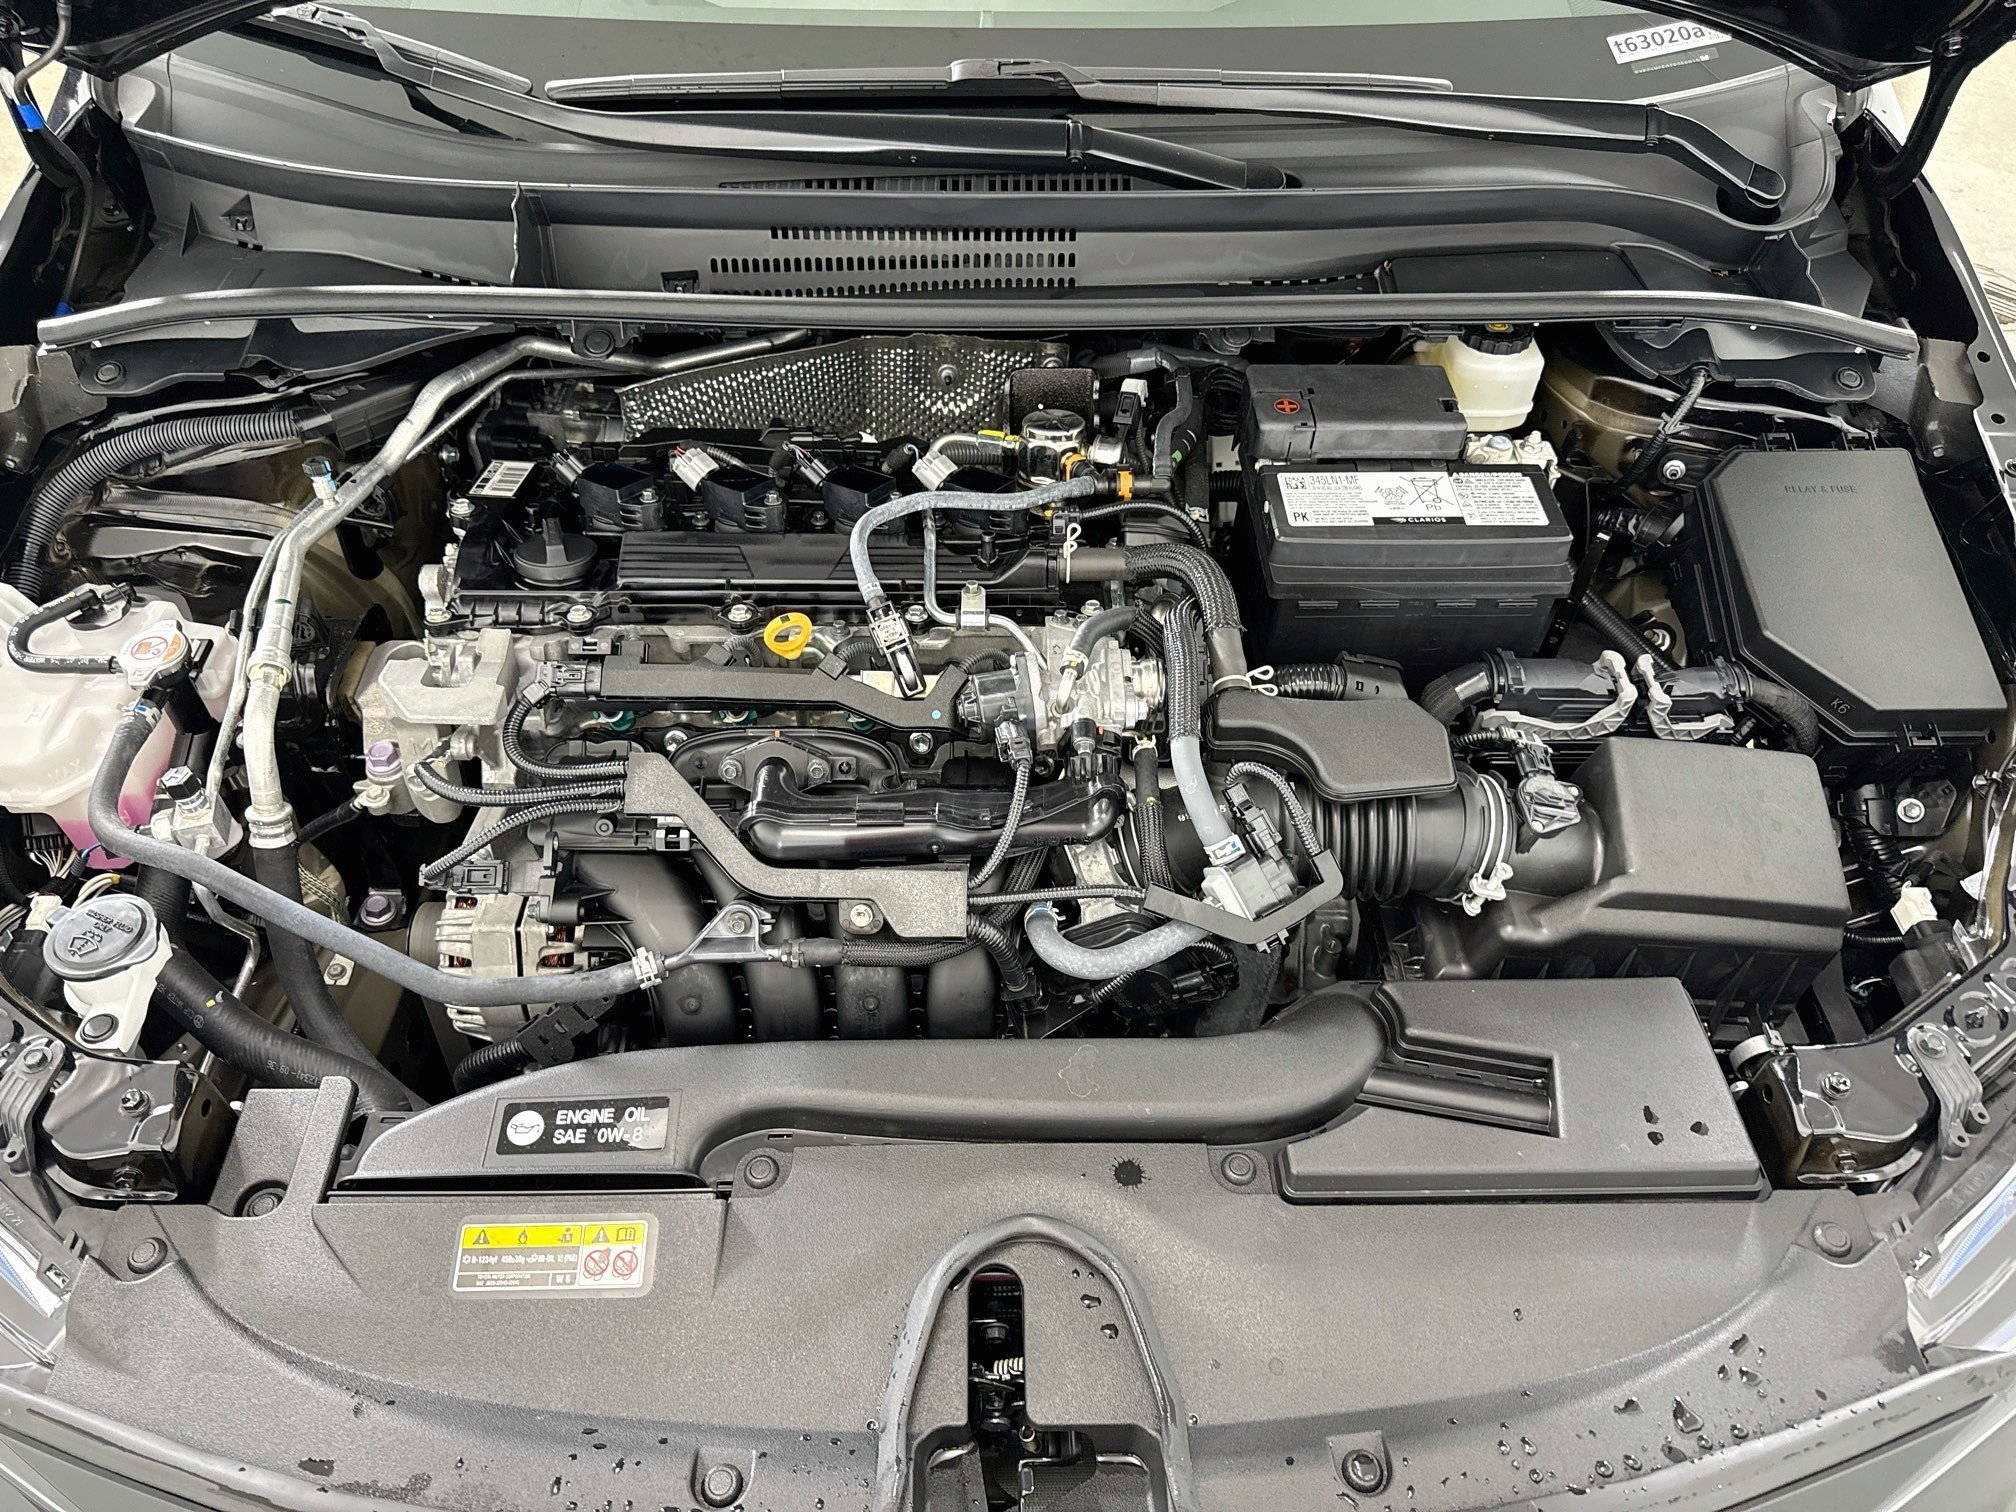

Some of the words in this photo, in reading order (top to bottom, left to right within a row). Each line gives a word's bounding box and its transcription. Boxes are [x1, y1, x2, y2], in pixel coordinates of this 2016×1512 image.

[1614, 26, 1705, 54] t63020a
[1309, 475, 1360, 486] 345LN1-MF
[1784, 485, 1817, 494] RELAY
[1830, 485, 1857, 494] FUSE
[1293, 512, 1310, 522] PK
[1830, 697, 1851, 714] K6
[556, 1107, 615, 1125] ENGINE
[624, 1106, 650, 1122] OIL
[552, 1128, 588, 1145] SAE
[597, 1126, 643, 1143] 0W-8
